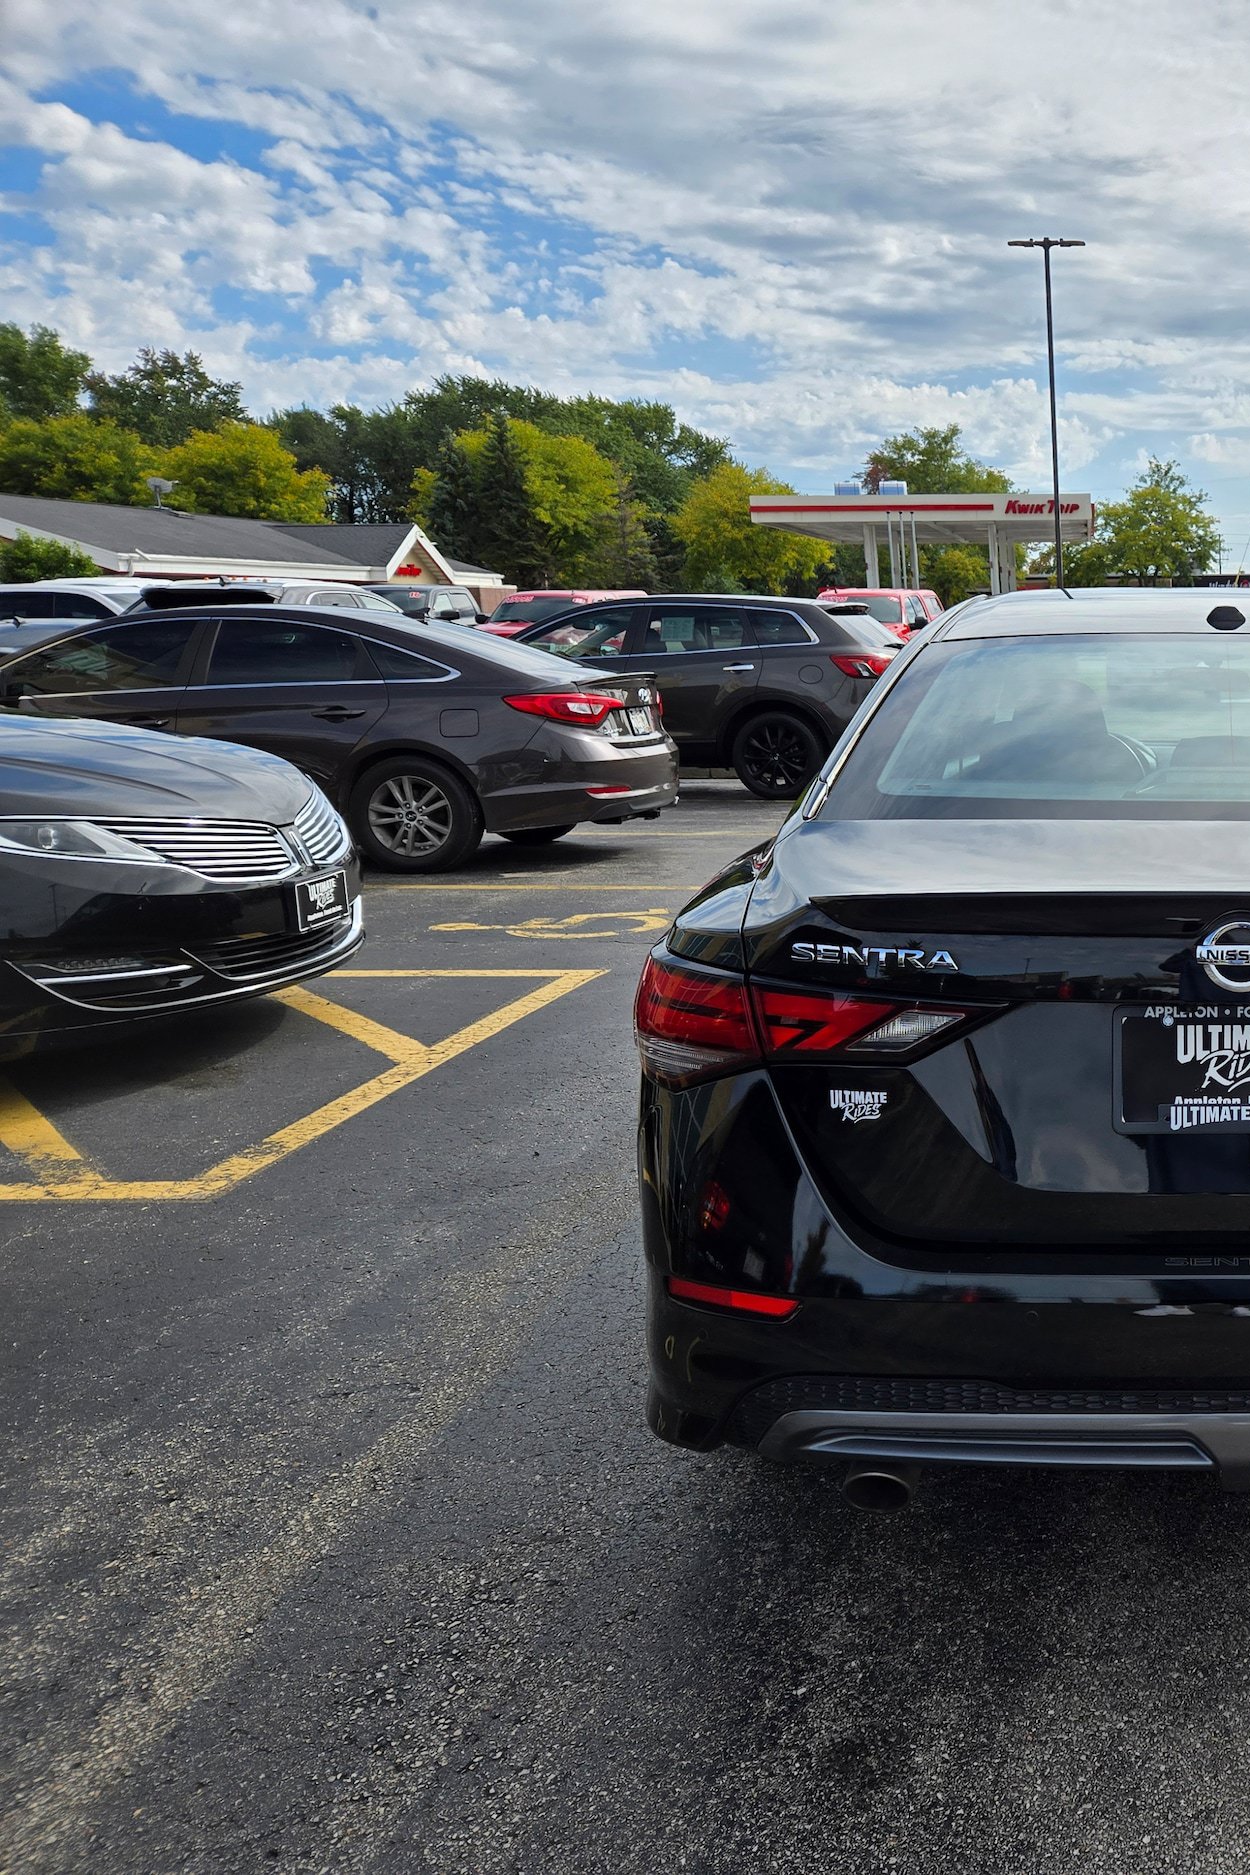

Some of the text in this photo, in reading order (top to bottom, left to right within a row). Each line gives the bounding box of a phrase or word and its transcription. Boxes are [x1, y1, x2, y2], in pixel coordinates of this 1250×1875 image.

[1005, 500, 1046, 514] KWIK
[791, 943, 959, 971] SENTRA
[829, 1089, 888, 1109] ULTIMATE
[1170, 1105, 1250, 1131] ULTIMATE
